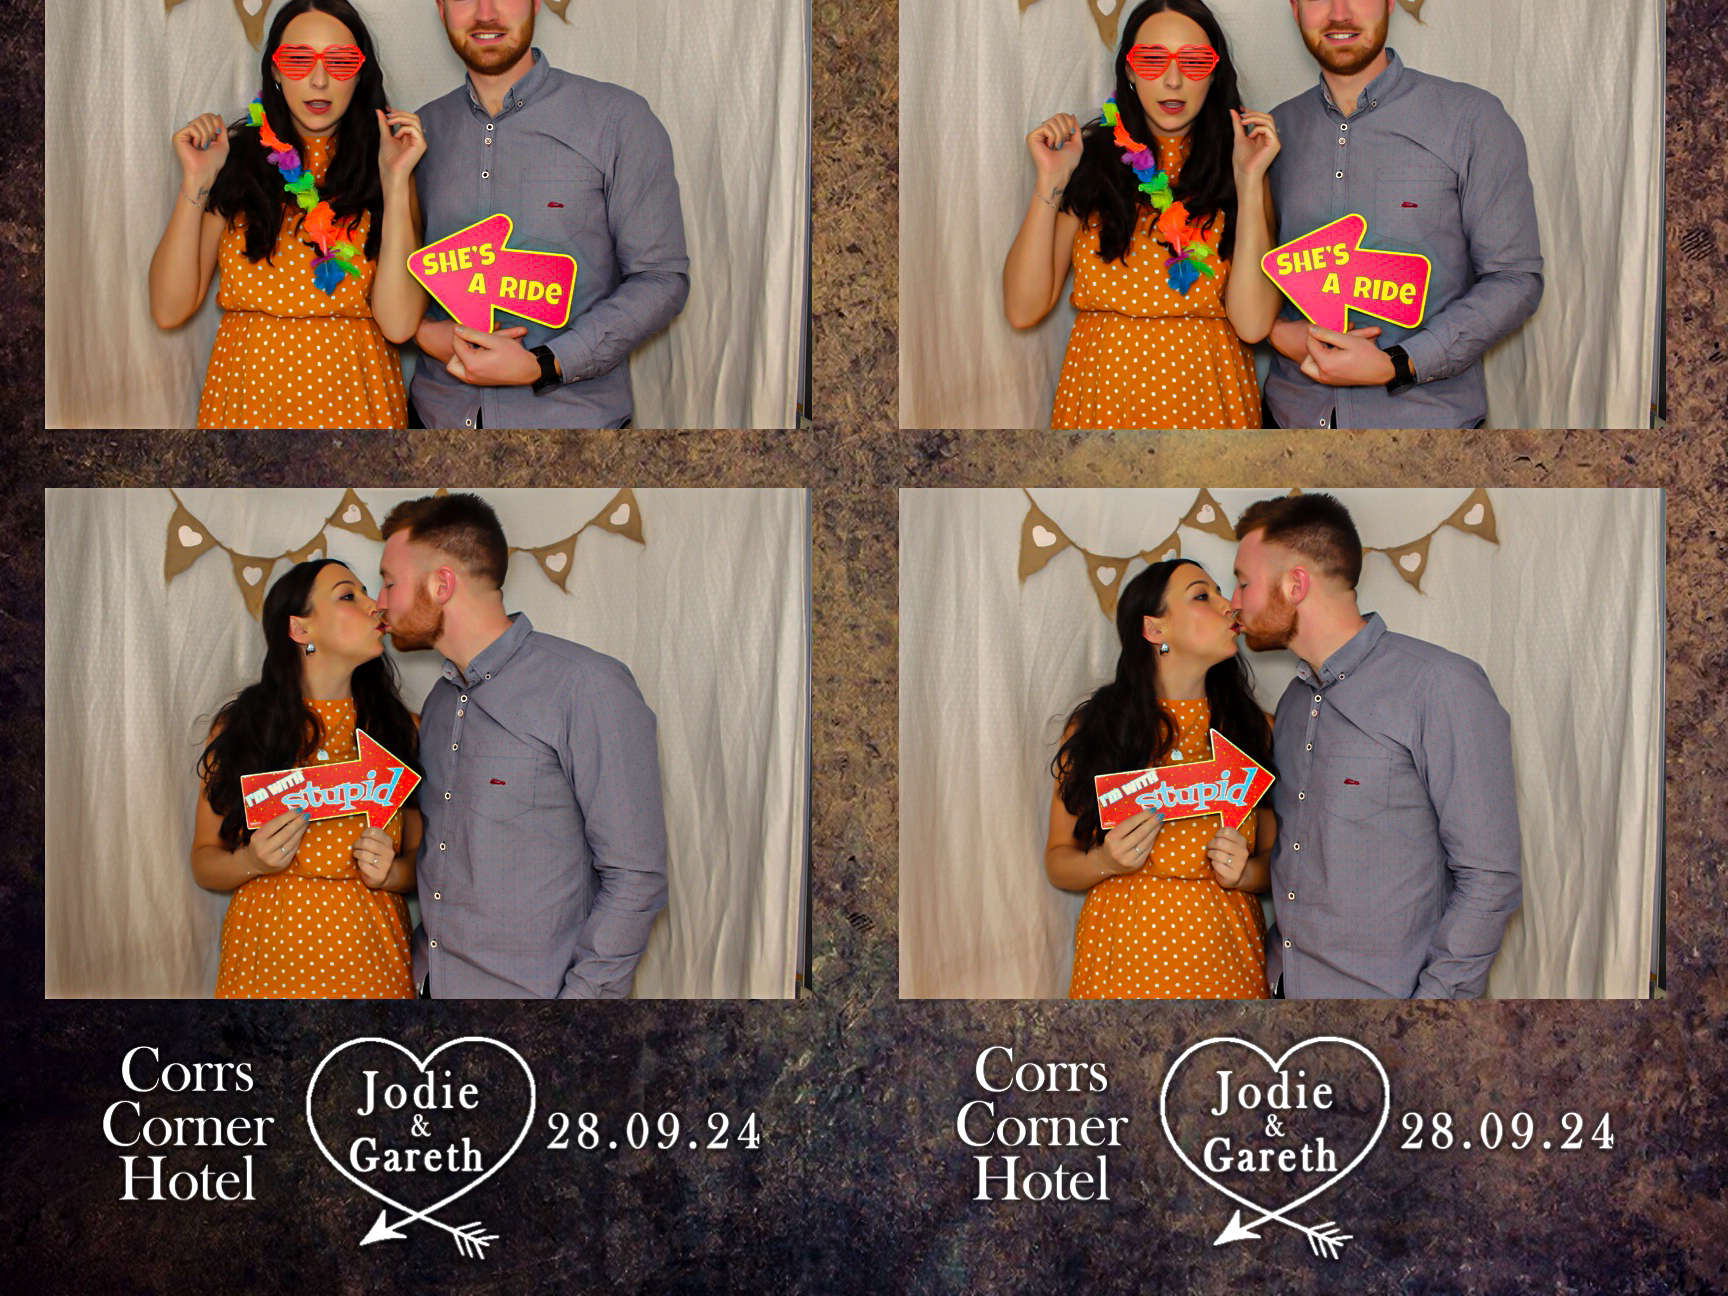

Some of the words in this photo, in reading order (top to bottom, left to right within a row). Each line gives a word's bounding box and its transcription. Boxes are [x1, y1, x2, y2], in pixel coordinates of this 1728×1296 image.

[422, 242, 496, 276] SHE'S
[1276, 242, 1350, 276] SHE'S
[467, 272, 487, 295] A
[1321, 272, 1341, 295] A
[266, 770, 306, 796] WITH
[281, 767, 405, 811] stupid
[1120, 770, 1160, 796] WITH
[1135, 767, 1259, 811] stupid
